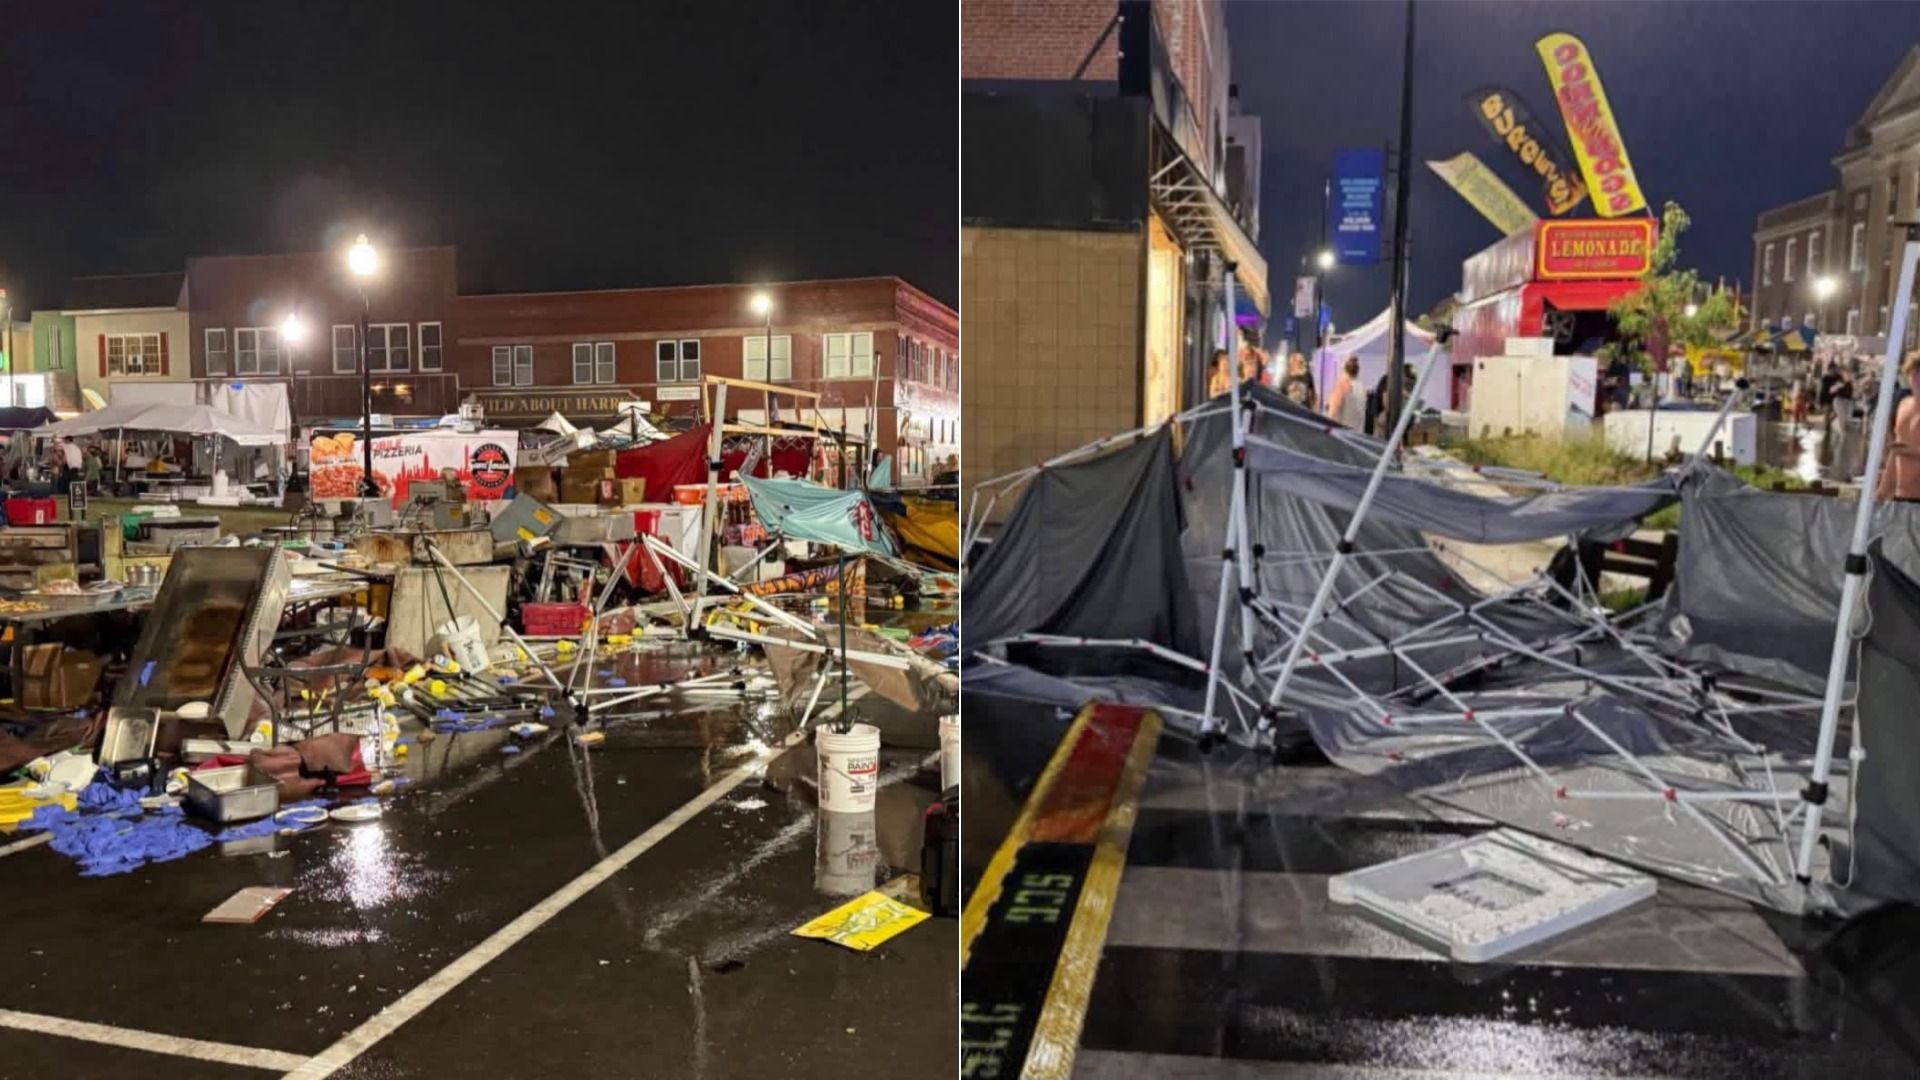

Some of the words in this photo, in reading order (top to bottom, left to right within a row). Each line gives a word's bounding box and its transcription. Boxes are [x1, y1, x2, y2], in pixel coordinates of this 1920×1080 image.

[1481, 94, 1570, 204] BURGERS
[1552, 240, 1642, 257] LEMONADE
[519, 398, 569, 411] ABOUT
[373, 444, 423, 459] PIZZERIA
